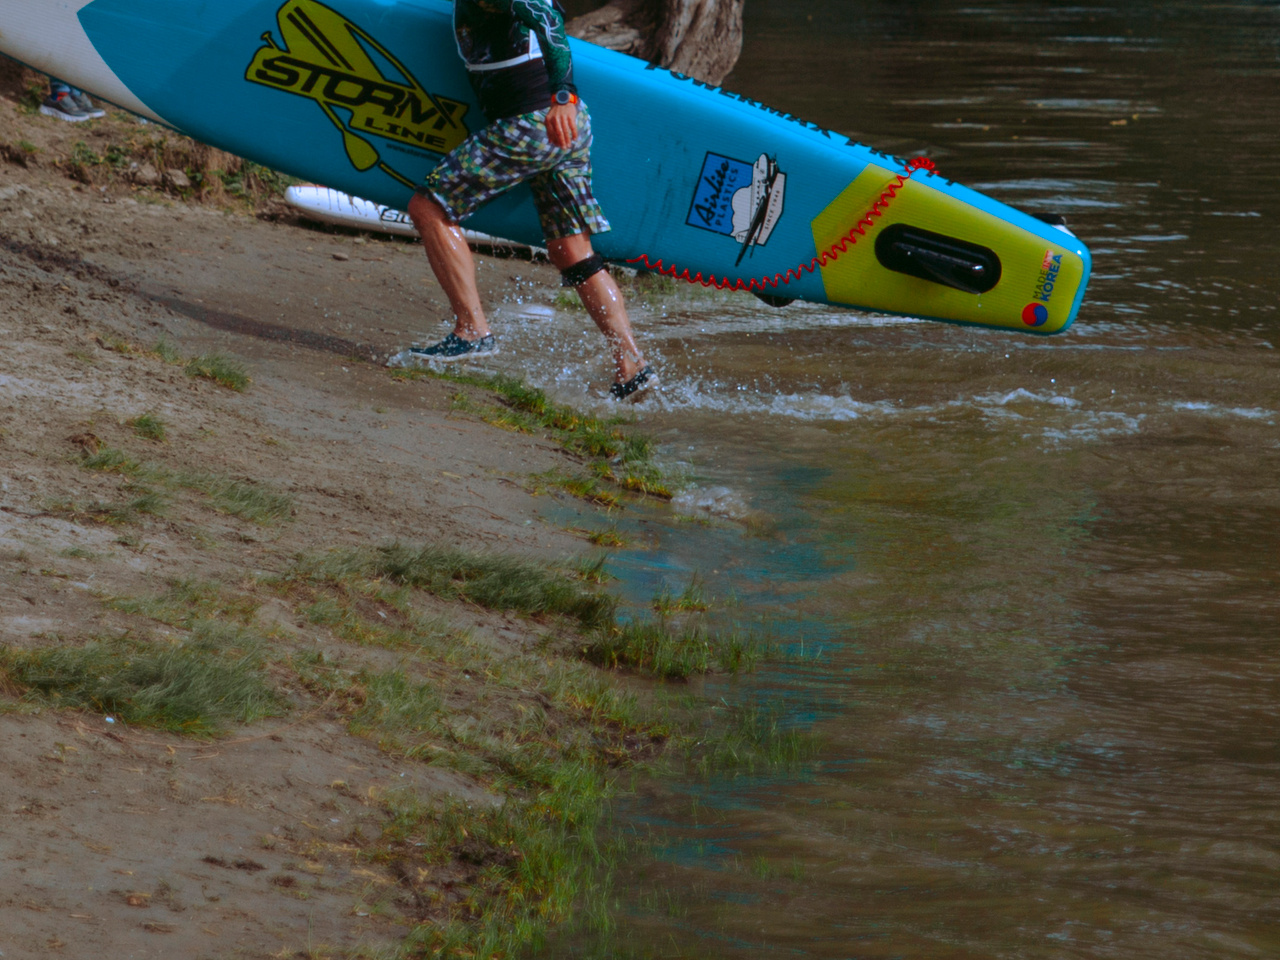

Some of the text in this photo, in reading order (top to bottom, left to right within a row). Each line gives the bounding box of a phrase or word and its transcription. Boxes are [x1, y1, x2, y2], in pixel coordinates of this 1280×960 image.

[255, 55, 458, 131] STORM
[365, 117, 447, 149] LINE
[694, 160, 730, 227] Airlite
[715, 168, 739, 227] PLASTICS
[764, 209, 775, 230] SINCE
[1033, 269, 1048, 300] MADE
[1040, 254, 1063, 302] KOREA
